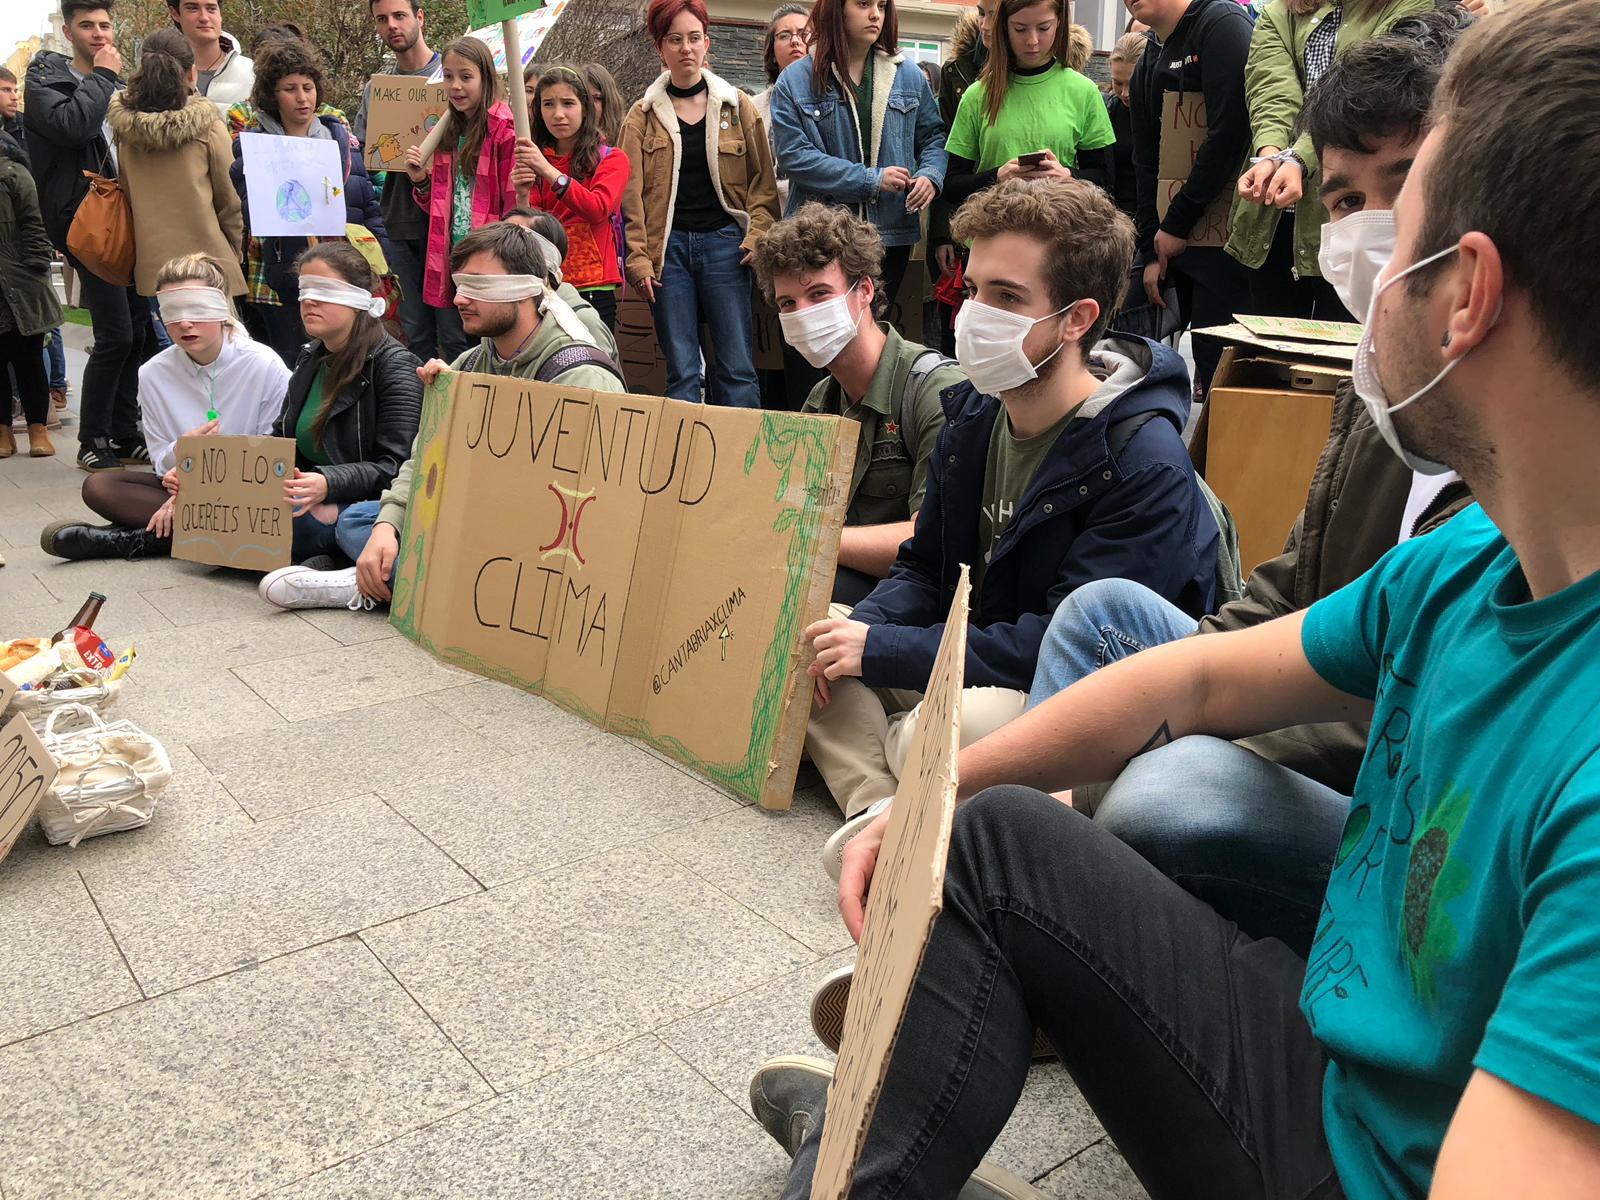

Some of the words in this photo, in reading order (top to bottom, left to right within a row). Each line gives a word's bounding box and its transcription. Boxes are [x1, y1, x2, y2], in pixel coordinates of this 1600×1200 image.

[373, 87, 401, 102] MAKE
[407, 87, 428, 102] OUR
[200, 447, 229, 485] NO
[241, 449, 269, 486] LO
[466, 384, 717, 505] JUVENTUD
[181, 496, 240, 534] QUERÉIS
[247, 506, 282, 538] VER
[473, 556, 608, 667] CLIMA
[651, 586, 747, 695] @CANTABRIAXCLIMA
